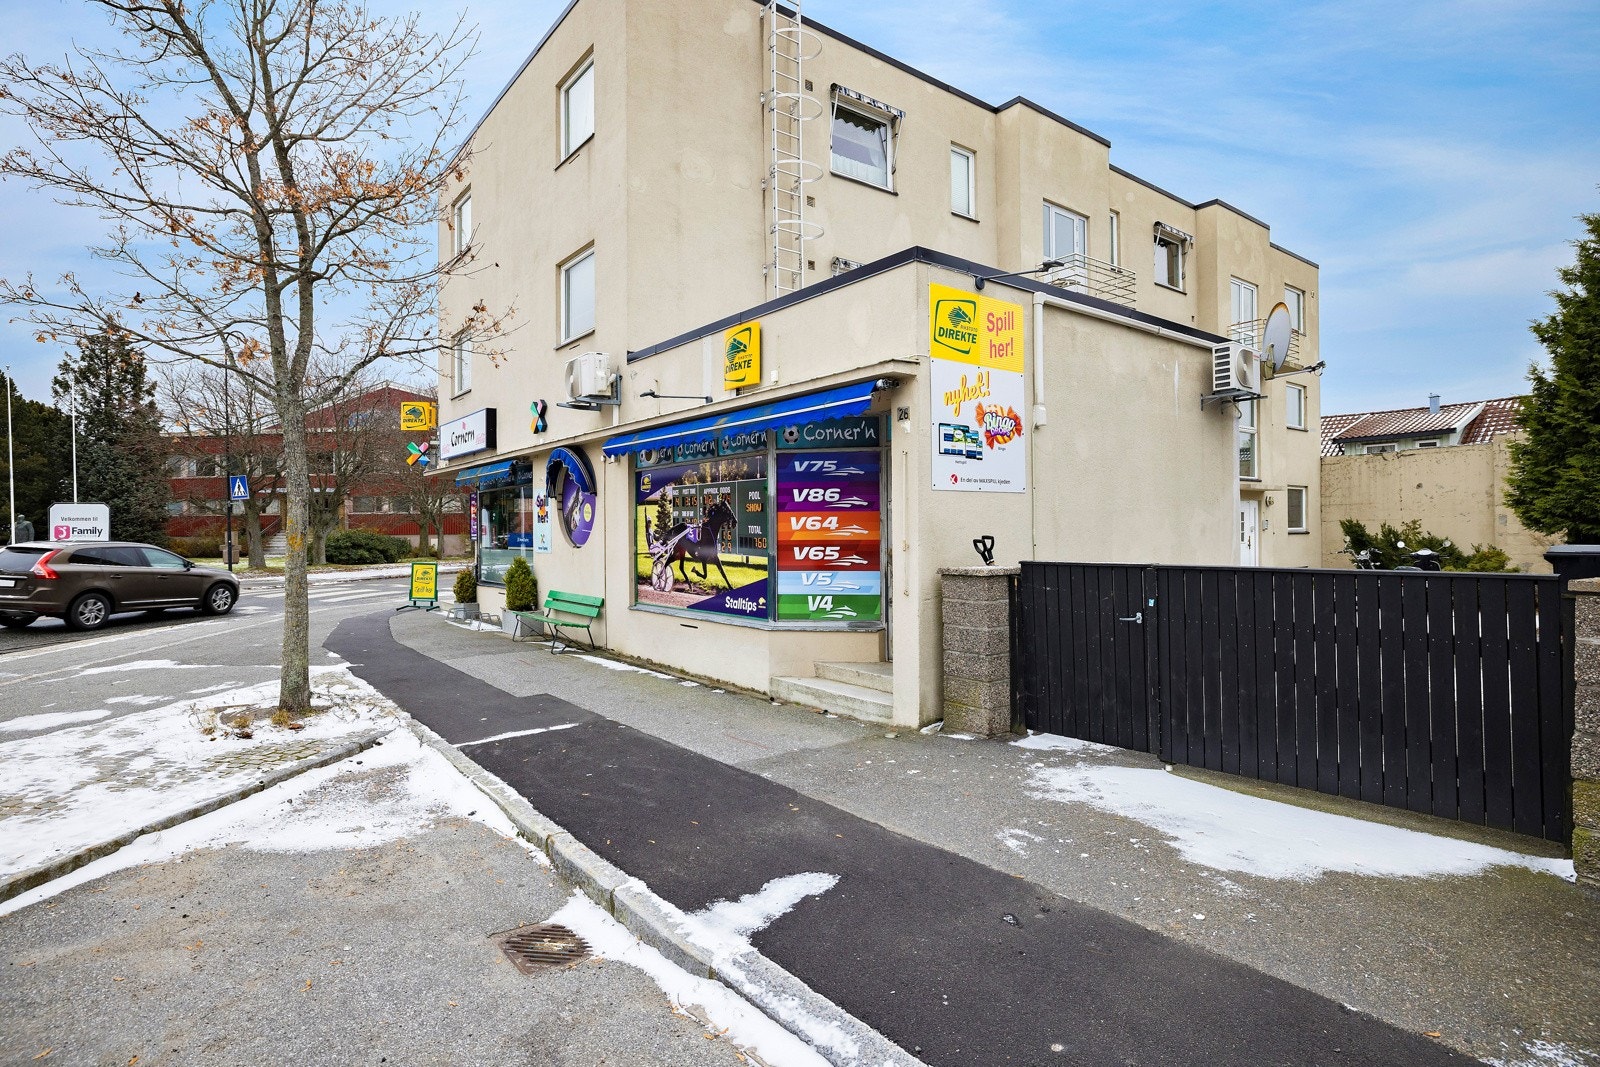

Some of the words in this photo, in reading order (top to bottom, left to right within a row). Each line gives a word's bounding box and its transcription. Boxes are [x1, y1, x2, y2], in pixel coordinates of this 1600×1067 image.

[986, 311, 1015, 336] Spill
[938, 327, 977, 344] DIREKTE
[989, 337, 1014, 359] her!
[725, 359, 753, 375] DIREKTE
[943, 370, 991, 417] nyhet!
[899, 408, 908, 420] 26
[984, 412, 1016, 433] Bingo
[803, 420, 877, 441] Corner'n
[794, 460, 837, 472] V75
[748, 491, 761, 500] POOL
[792, 488, 841, 502] V86
[746, 503, 762, 512] SHOW
[748, 525, 762, 534] TOTAL
[790, 516, 839, 530] V64
[71, 526, 103, 538] Family
[793, 546, 840, 560] V65
[801, 572, 832, 586] V5
[725, 596, 757, 613] Stalltips
[807, 595, 834, 611] V4
